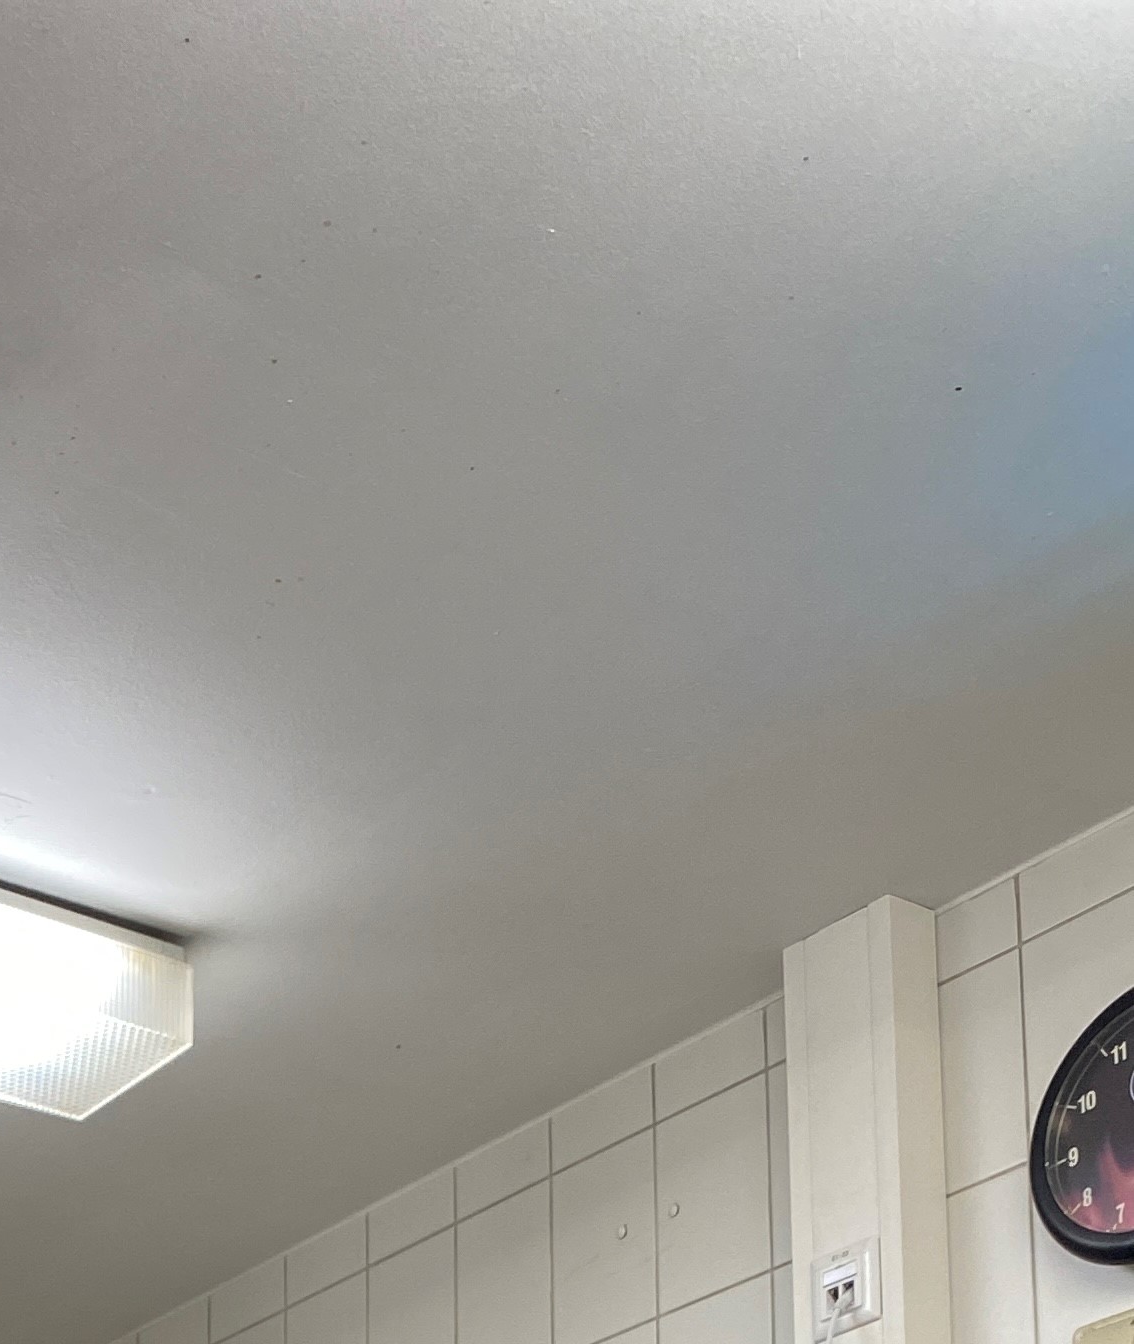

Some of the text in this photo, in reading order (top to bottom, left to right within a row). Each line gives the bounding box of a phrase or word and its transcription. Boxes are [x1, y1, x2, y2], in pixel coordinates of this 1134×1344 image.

[1110, 1041, 1128, 1065] 11
[1077, 1090, 1097, 1114] 10
[1068, 1147, 1079, 1167] 9
[1082, 1187, 1093, 1207] 8
[1115, 1202, 1126, 1224] 7
